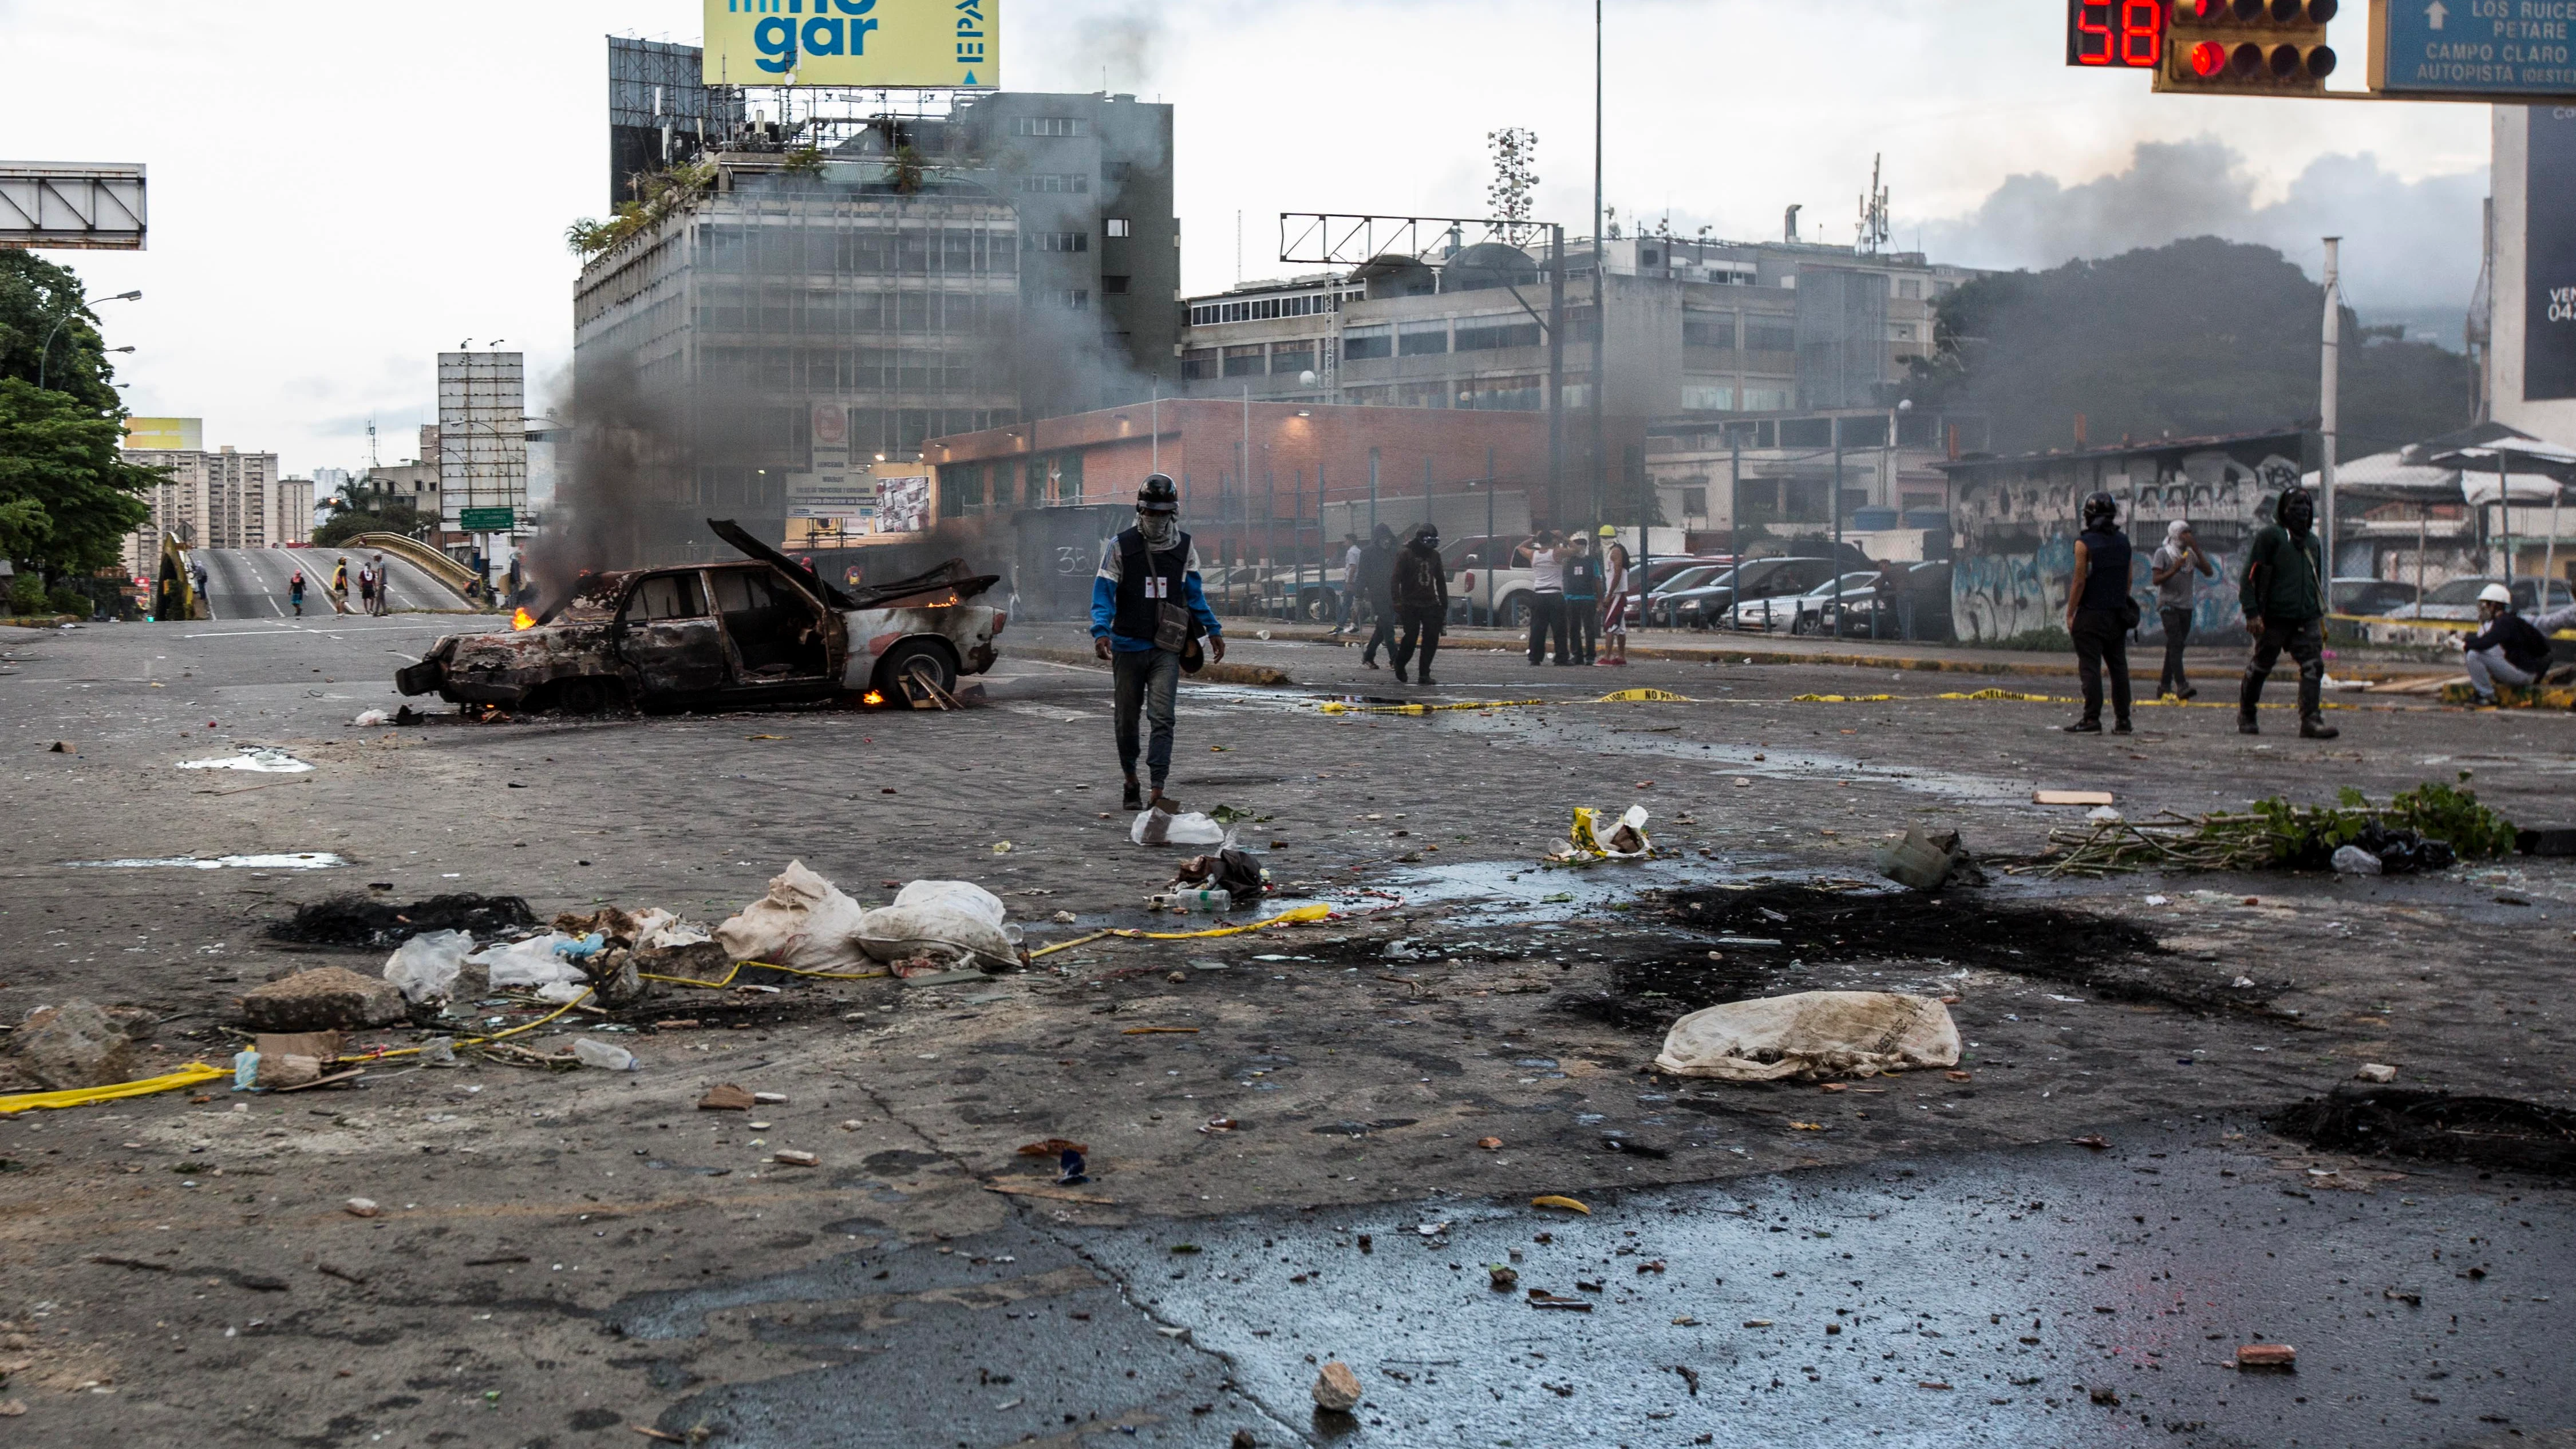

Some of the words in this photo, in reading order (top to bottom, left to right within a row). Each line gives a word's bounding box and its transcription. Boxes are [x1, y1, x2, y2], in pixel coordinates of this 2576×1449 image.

[2472, 1, 2509, 18] LOS
[2078, 0, 2160, 66] 58
[2494, 21, 2567, 39] PETARE
[754, 16, 878, 73] gar
[2426, 43, 2494, 61] CAMPO
[2503, 45, 2567, 63] CLARO
[2417, 63, 2514, 81] AUTOPISTA
[1645, 690, 1657, 700] NO
